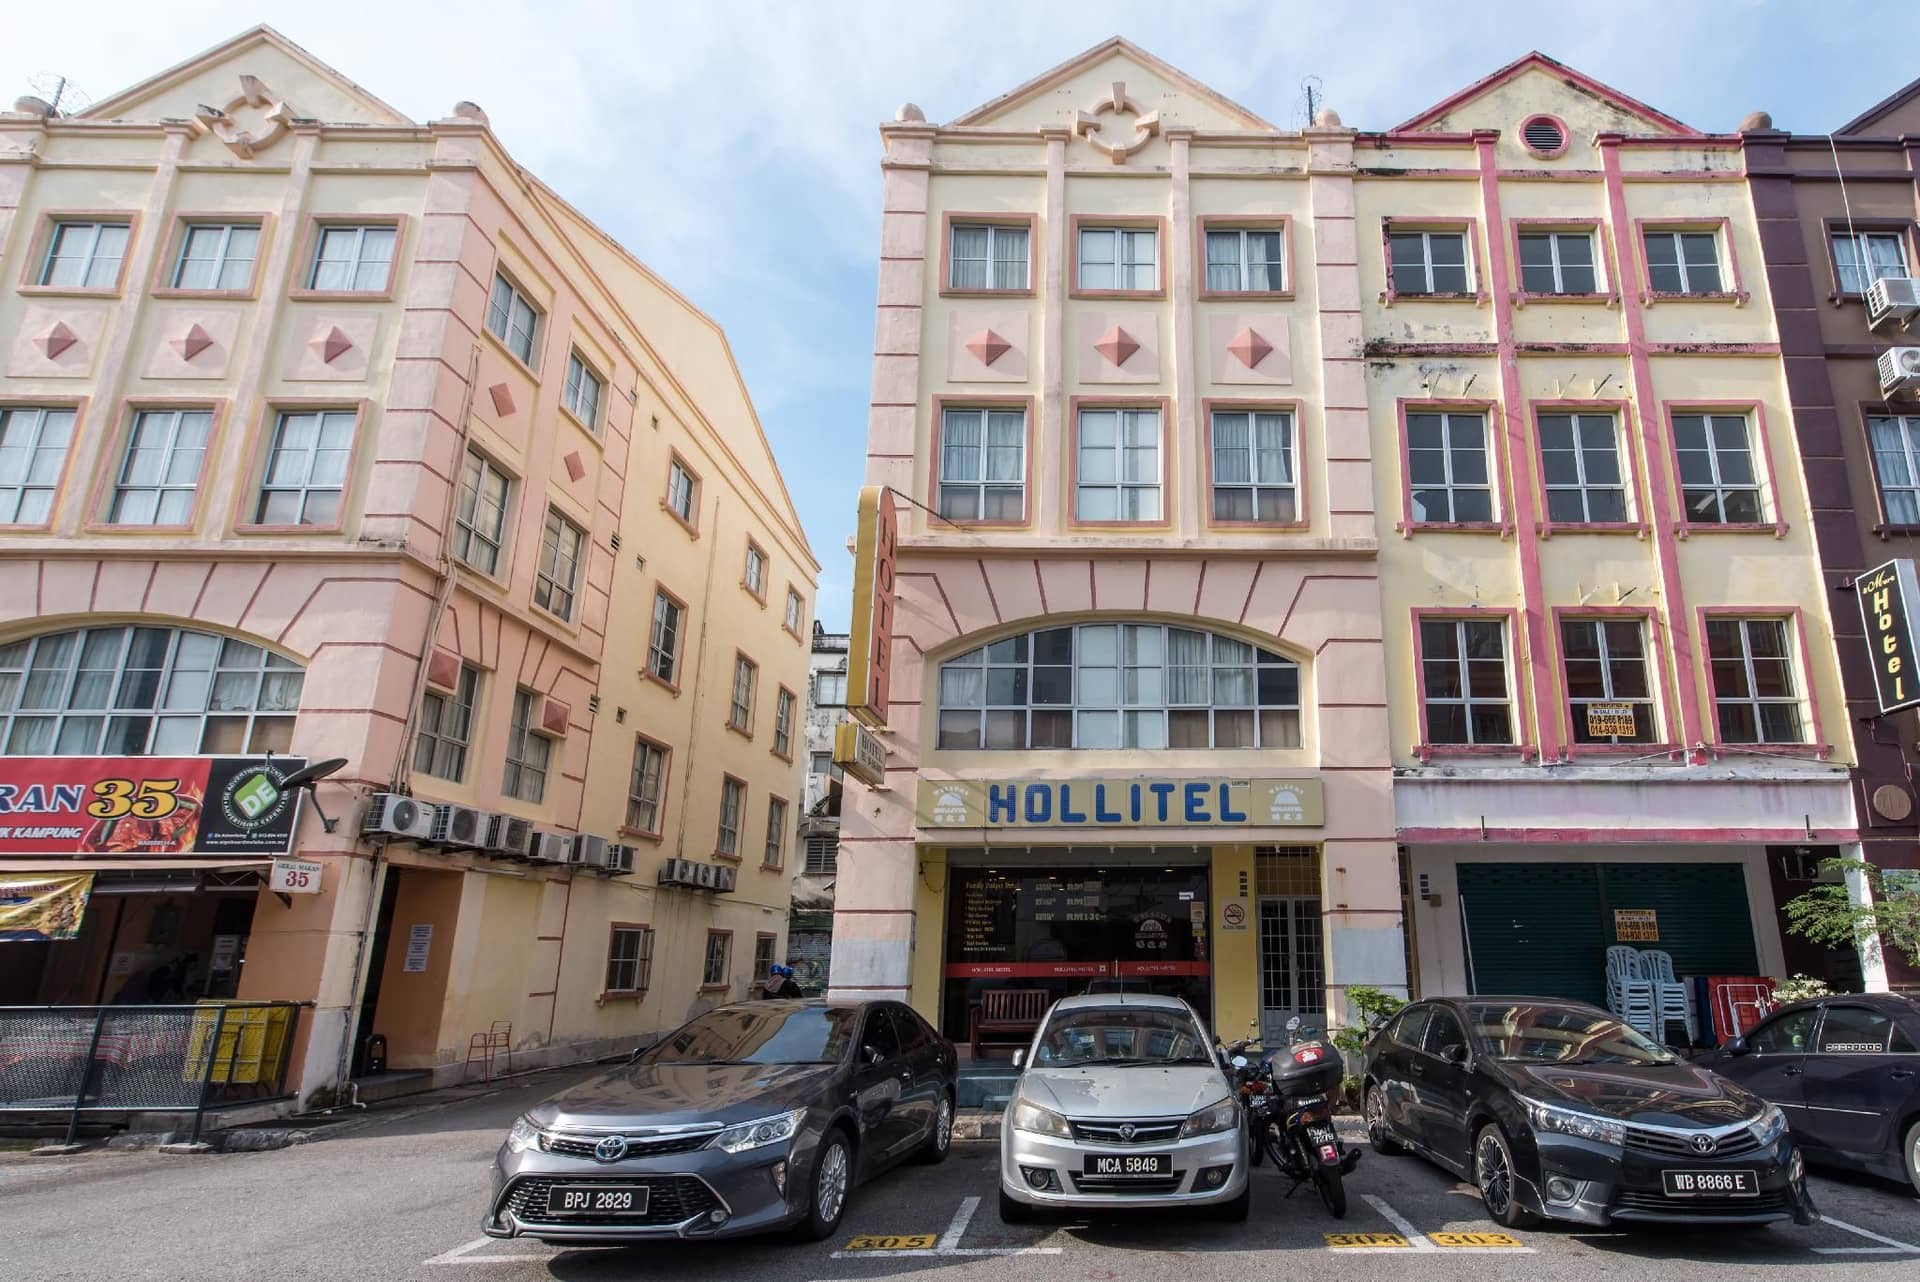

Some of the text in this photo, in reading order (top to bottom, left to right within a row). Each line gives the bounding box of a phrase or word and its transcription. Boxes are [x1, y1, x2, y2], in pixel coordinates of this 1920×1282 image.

[874, 515, 895, 713] HOTEL
[1873, 588, 1905, 700] Hotel
[87, 778, 182, 819] 35
[989, 782, 1247, 823] HOLLITEL
[13, 827, 83, 839] KAMPUNG
[285, 870, 309, 888] 35
[1097, 1157, 1158, 1173] MCA 5849
[1675, 1174, 1746, 1190] WB 8866 E
[564, 1192, 633, 1209] BPJ 2829
[850, 1237, 926, 1249] 305
[1331, 1233, 1403, 1246] 304
[1437, 1233, 1514, 1246] 303
